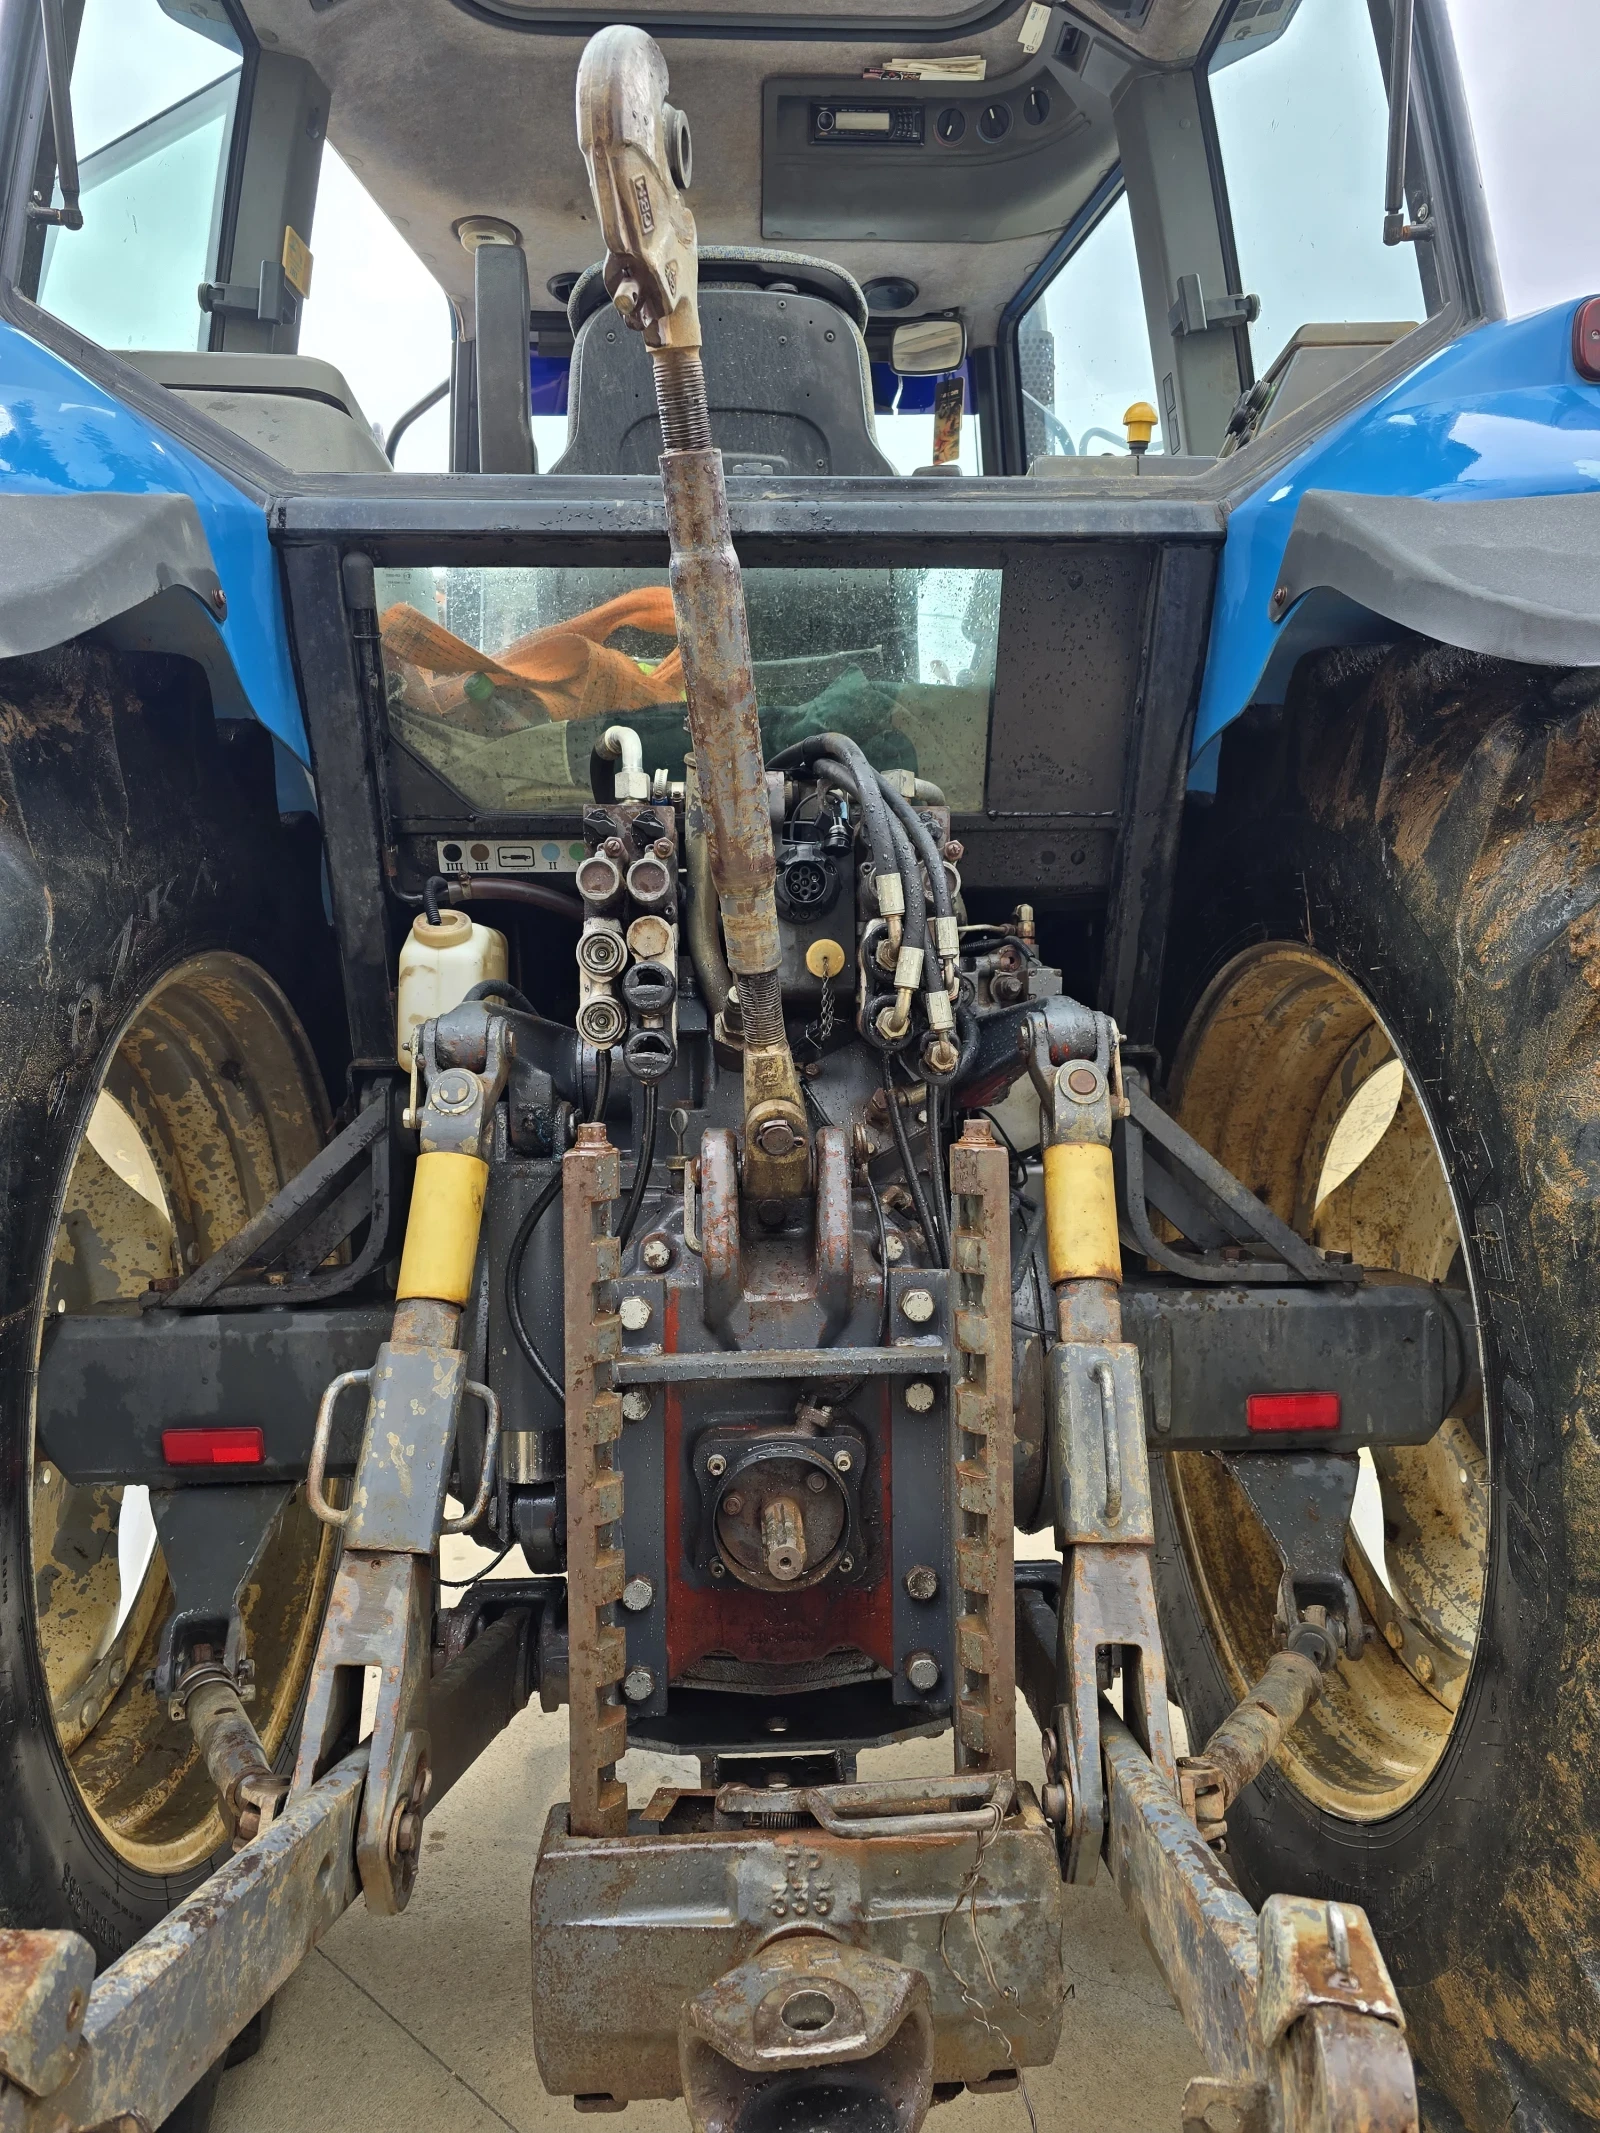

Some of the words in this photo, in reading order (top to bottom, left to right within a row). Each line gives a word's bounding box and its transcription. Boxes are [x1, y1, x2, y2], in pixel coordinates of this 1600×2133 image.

[475, 862, 489, 871] III
[548, 861, 558, 870] II
[770, 1880, 833, 1918] 335
